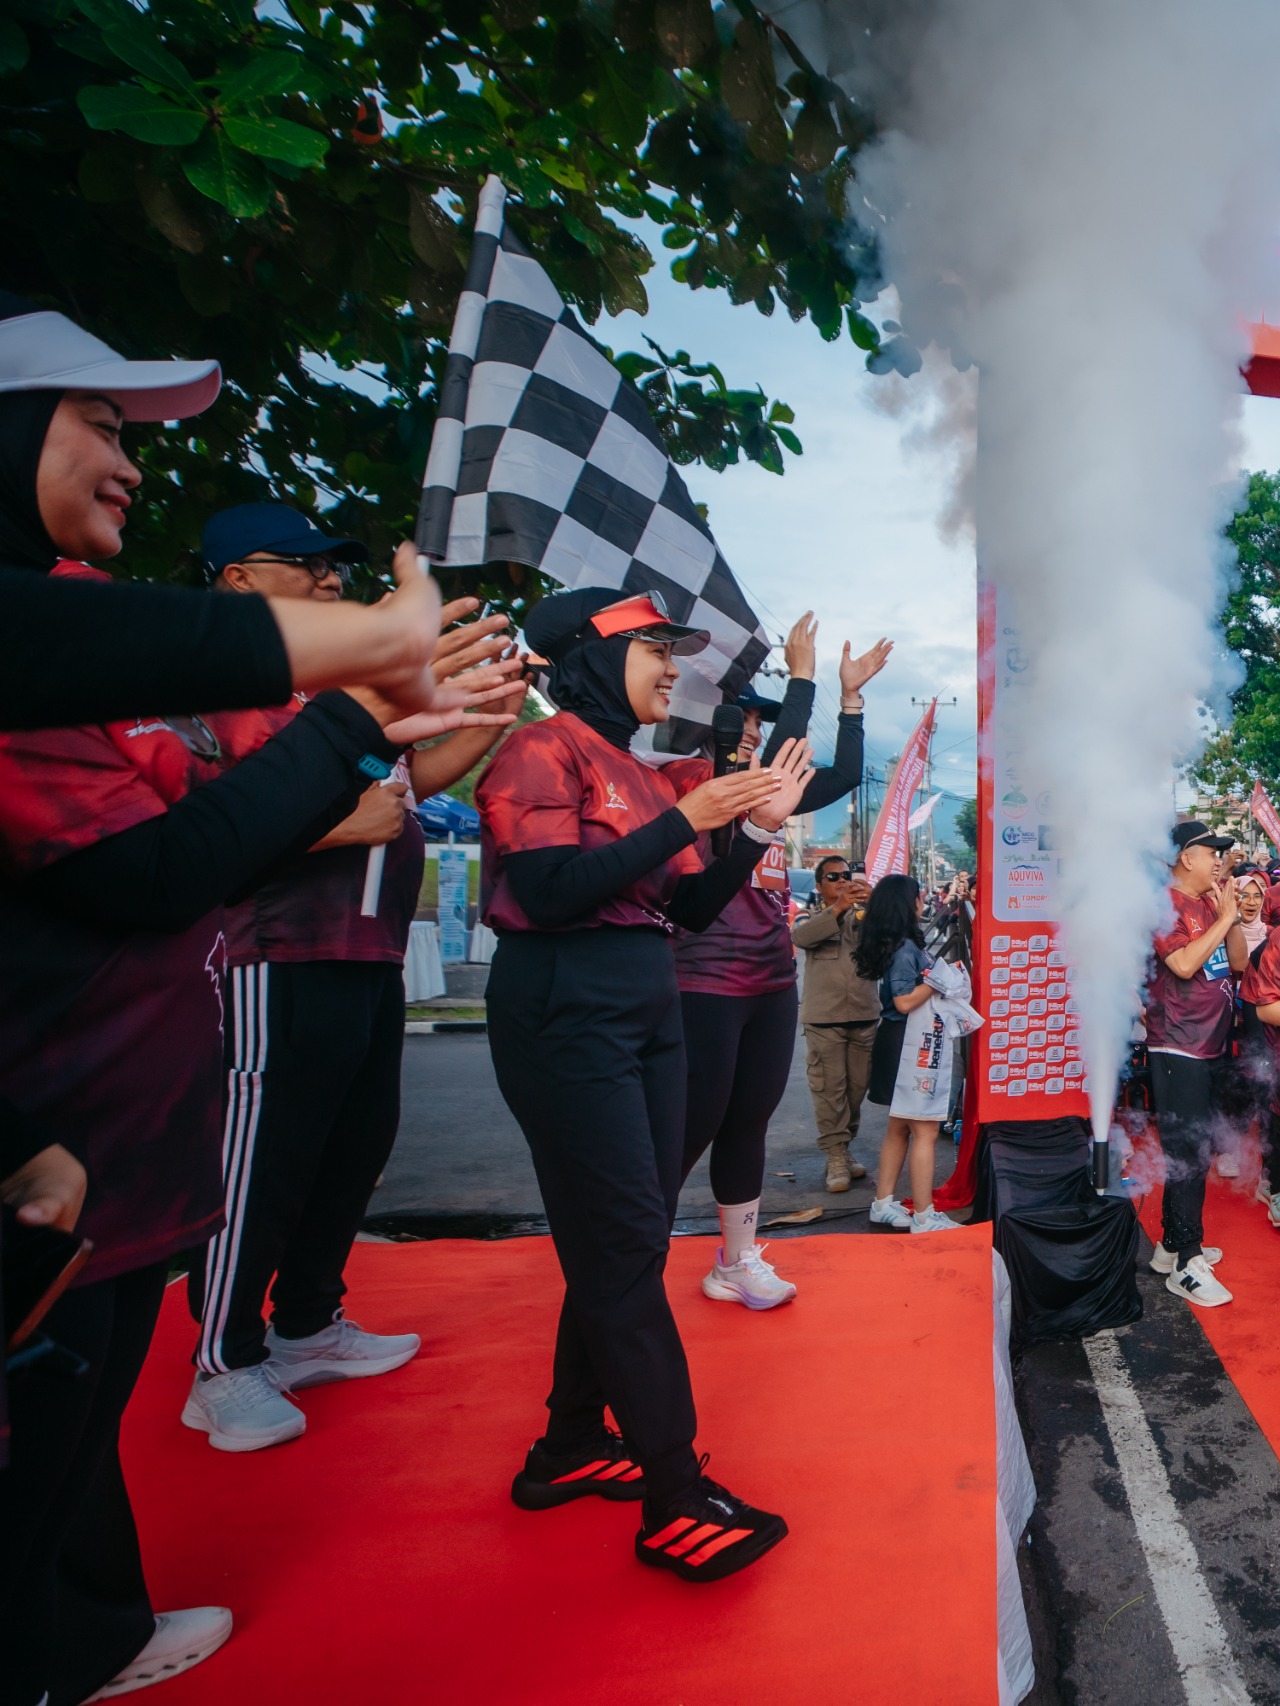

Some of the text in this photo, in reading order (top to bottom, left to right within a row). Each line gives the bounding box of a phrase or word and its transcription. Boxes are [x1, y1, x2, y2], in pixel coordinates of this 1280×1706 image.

[889, 850, 906, 876] ATAN
[901, 757, 926, 810] INDONESIA
[1008, 870, 1045, 882] AQUVIVA
